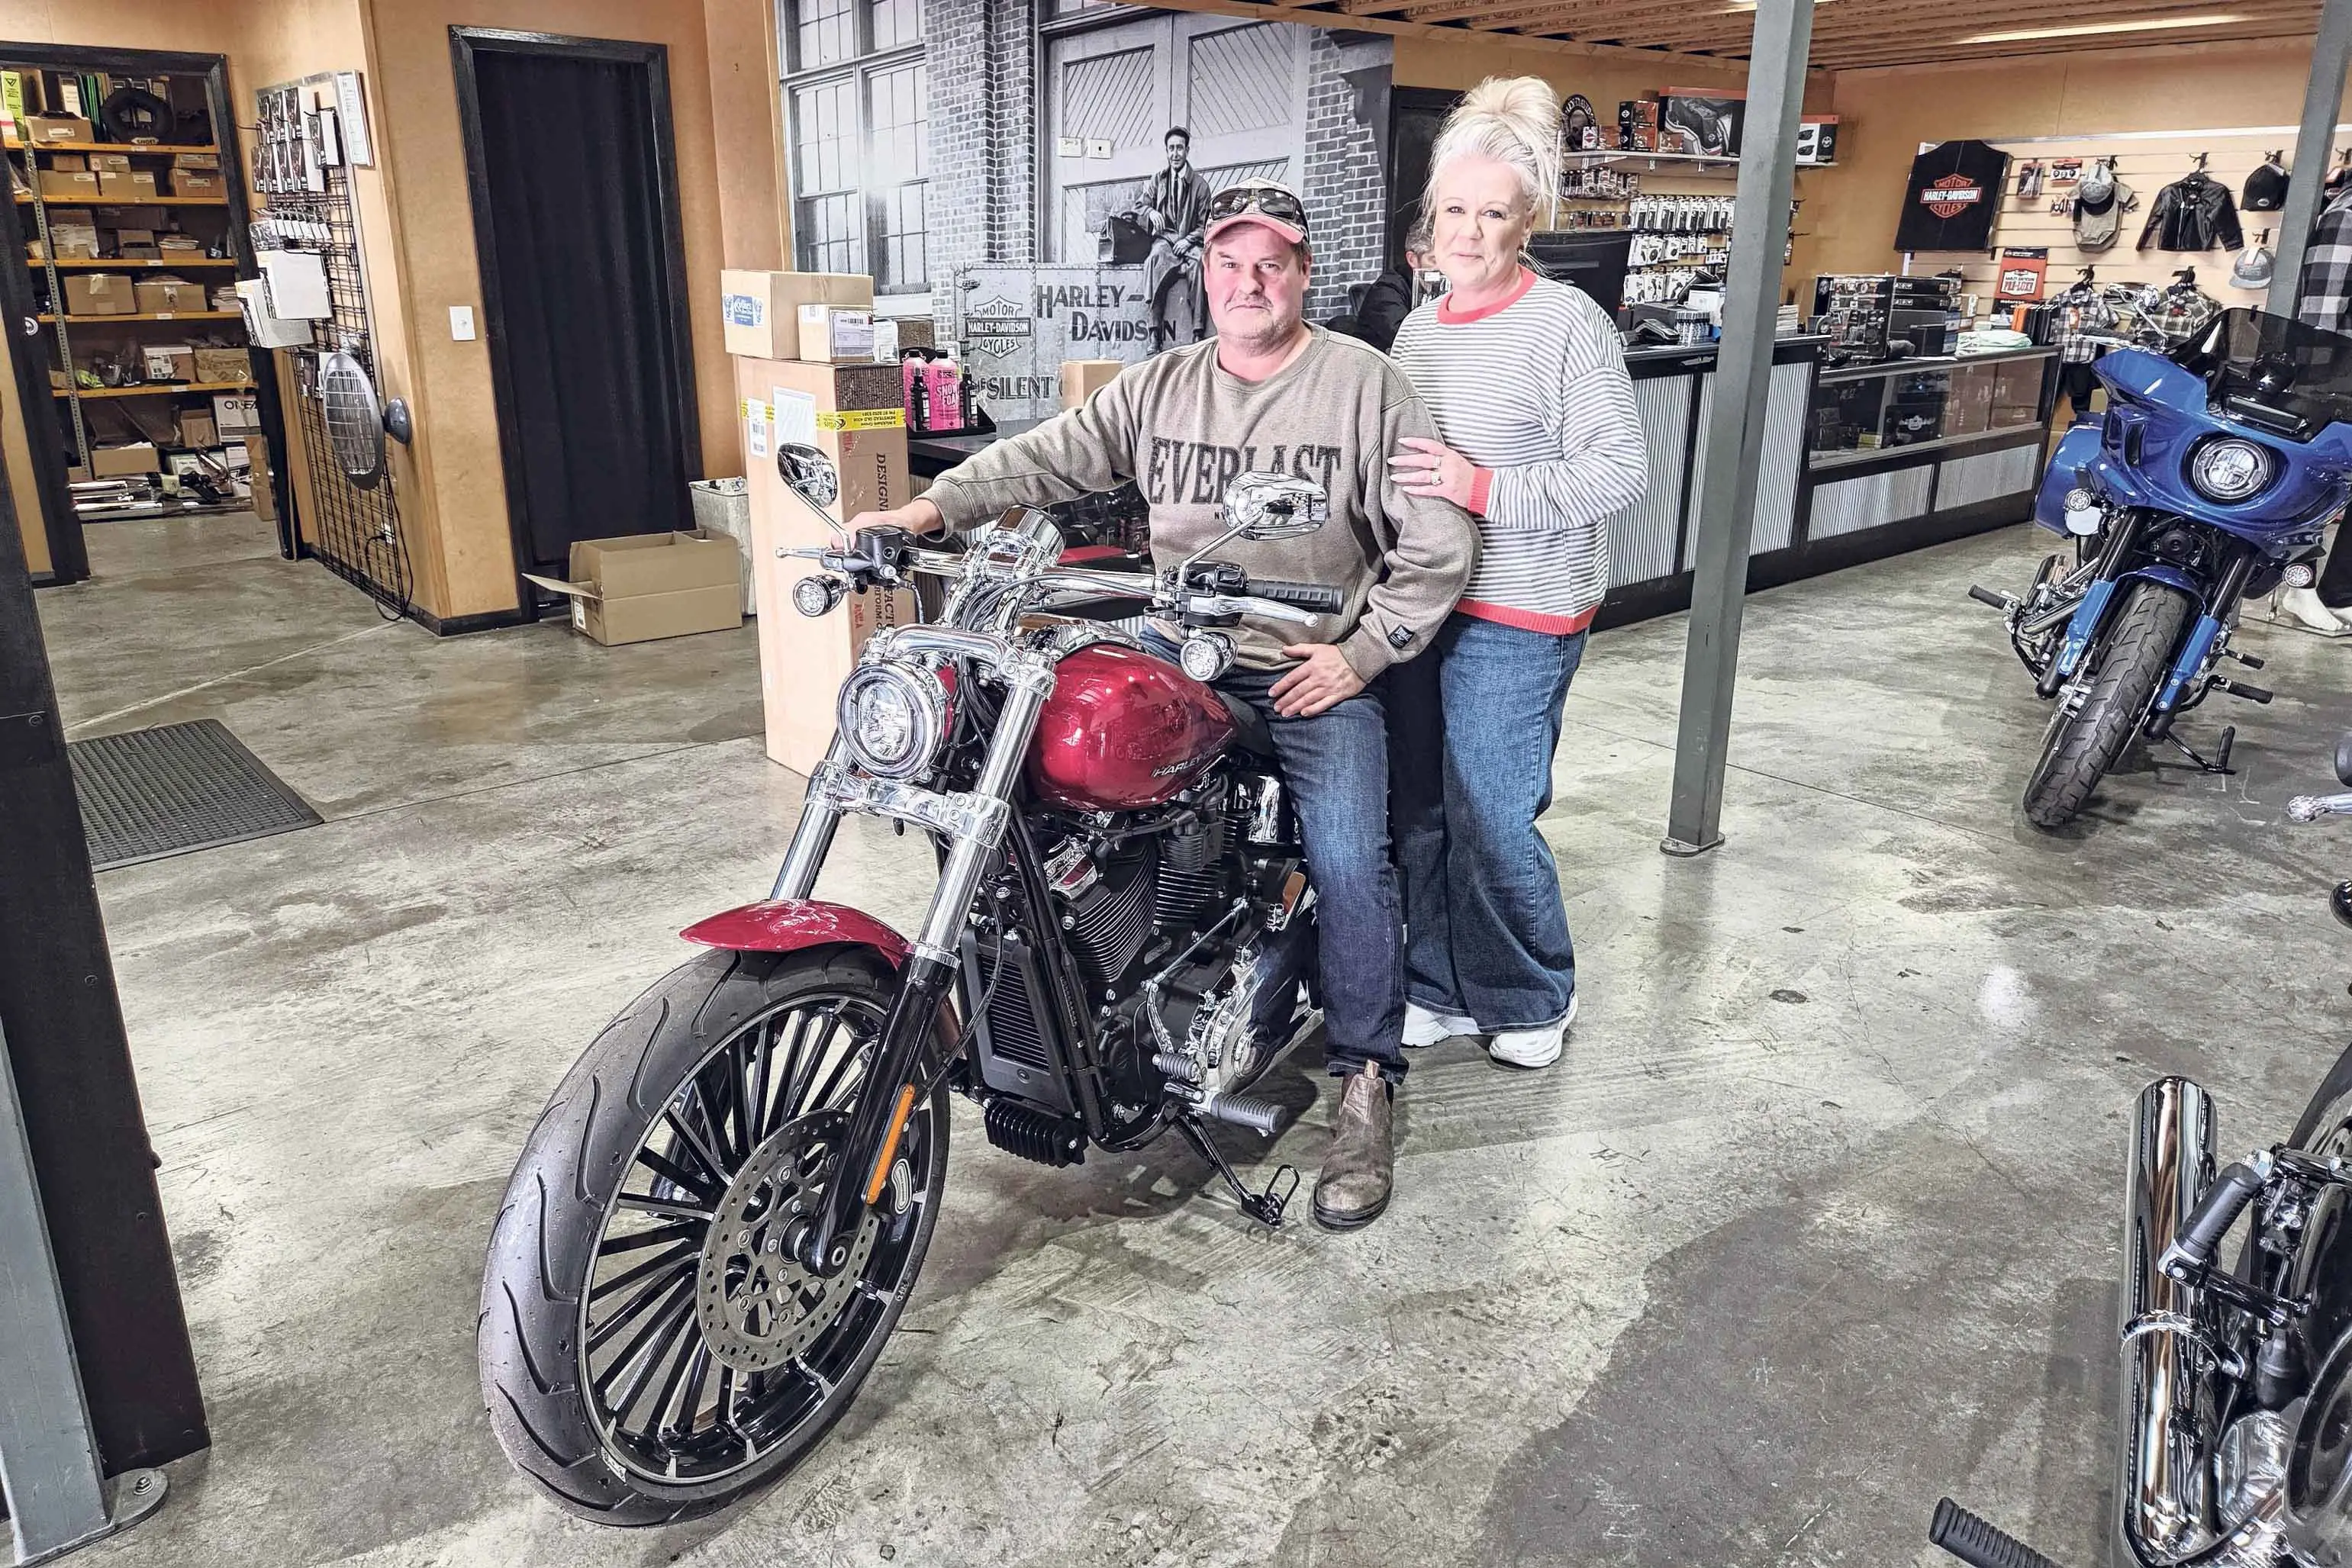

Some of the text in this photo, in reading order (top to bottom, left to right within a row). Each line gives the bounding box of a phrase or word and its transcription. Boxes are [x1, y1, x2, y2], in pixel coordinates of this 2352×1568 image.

[1938, 176, 1970, 188] MOTOR
[1923, 189, 1978, 201] HARLEY-DAVIDSON
[1933, 202, 1967, 215] CYCLES
[982, 300, 1014, 316] MOTOR
[968, 321, 1029, 333] HARLEY-DAVIDSON
[1071, 311, 1176, 342] DAVIDSN
[983, 338, 1015, 354] CYCLES
[987, 376, 1055, 400] SILENT
[875, 452, 890, 512] DESIGN
